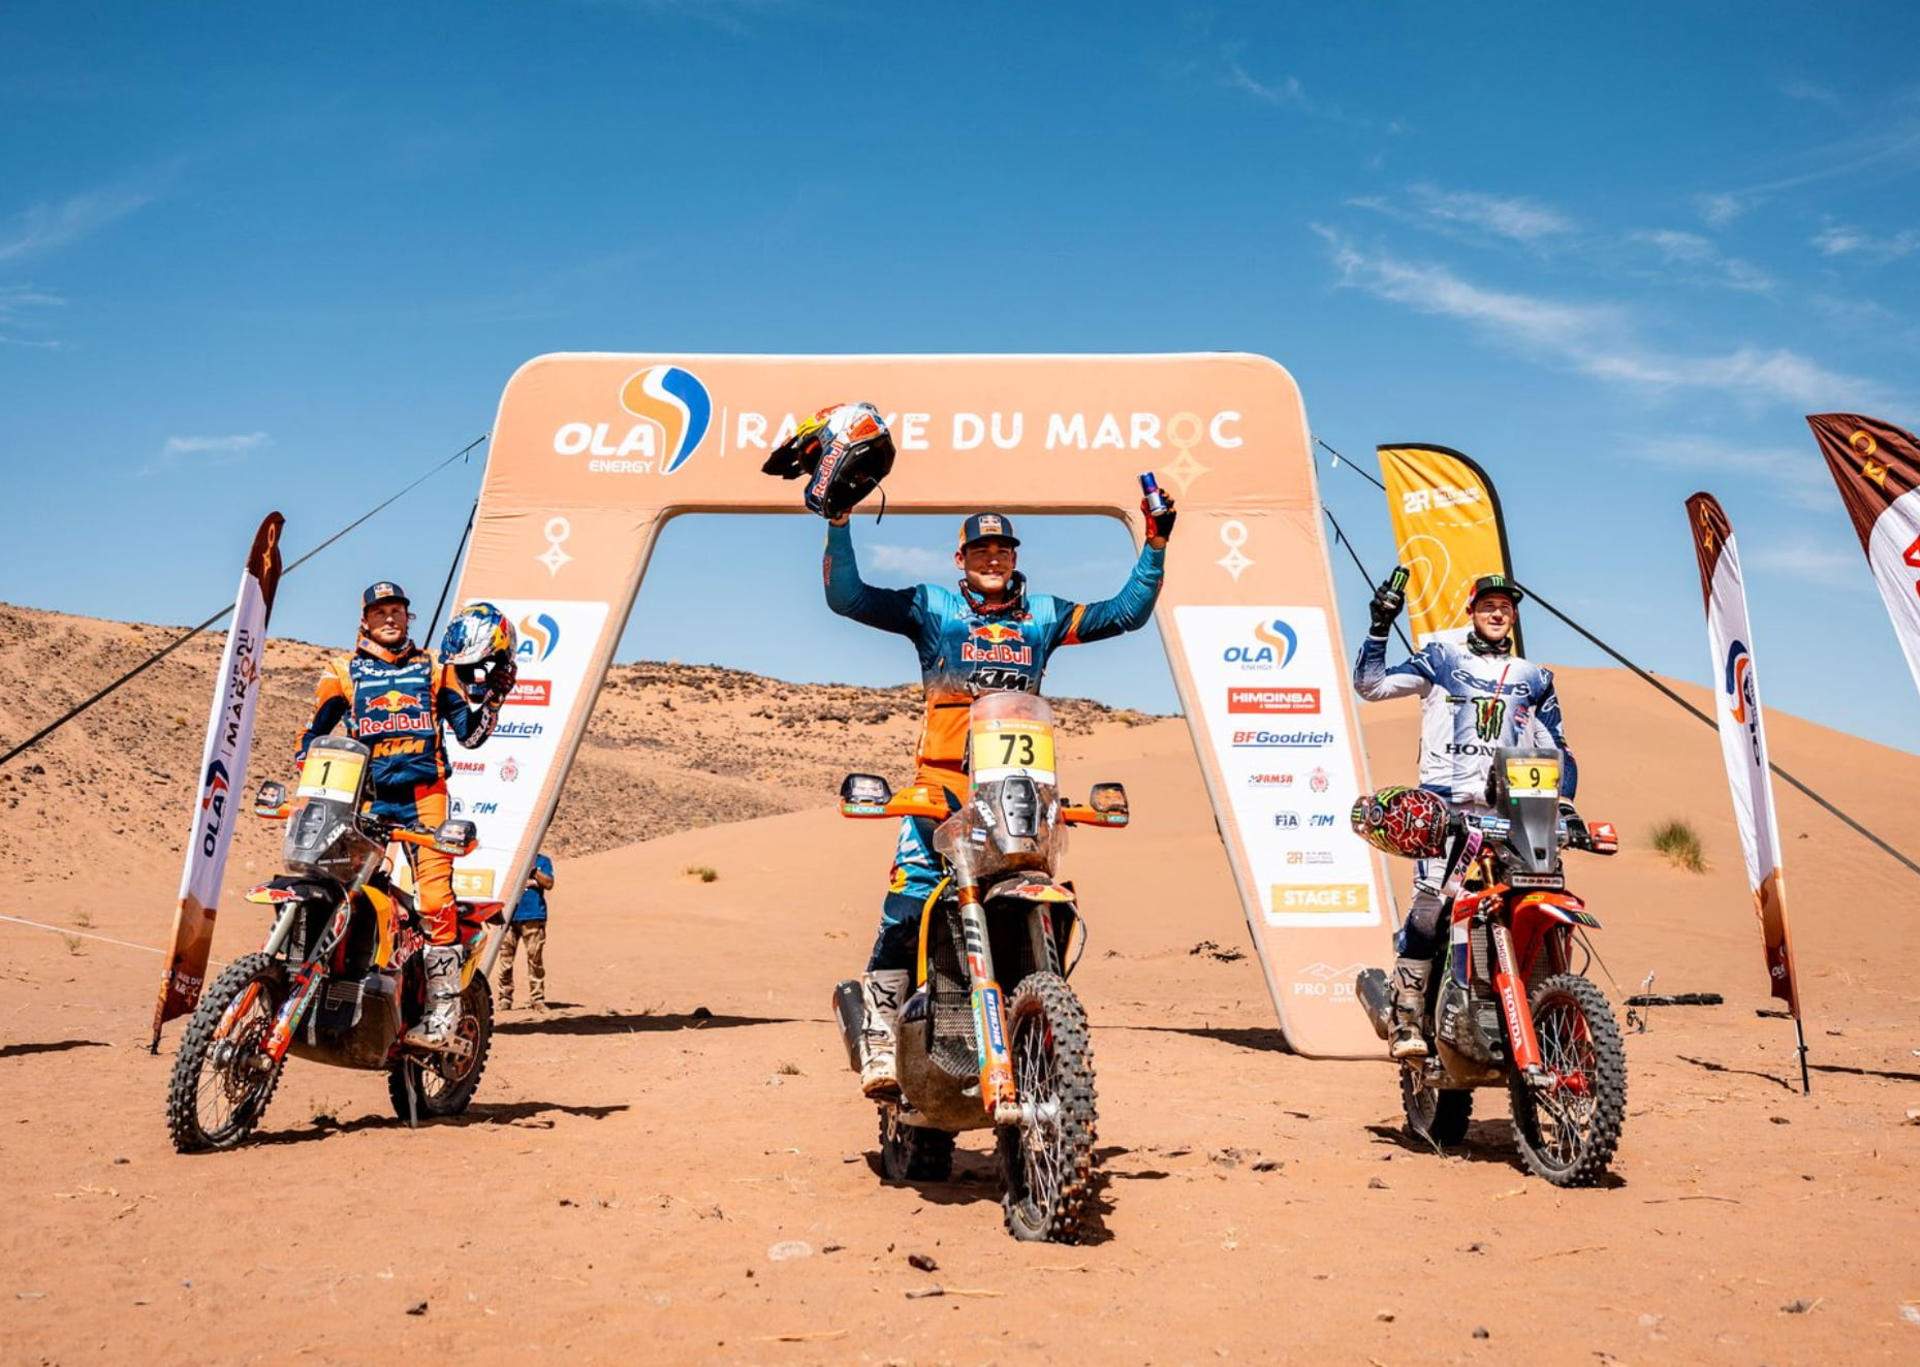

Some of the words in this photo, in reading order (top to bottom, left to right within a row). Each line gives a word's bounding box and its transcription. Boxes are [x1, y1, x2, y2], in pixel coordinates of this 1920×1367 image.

[554, 422, 656, 457] OLA
[952, 411, 1024, 450] DU
[1045, 411, 1244, 450] MAROC
[589, 460, 655, 474] ENERGY
[961, 642, 1000, 662] Red
[1000, 645, 1033, 666] Bull
[1224, 647, 1272, 662] OLA
[968, 666, 1029, 692] KTM
[360, 713, 396, 737] Red
[396, 711, 433, 731] Bull
[372, 736, 426, 758] KTM
[1000, 734, 1035, 766] 73
[1232, 731, 1334, 744] BFGoodrich
[1445, 743, 1496, 758] HON
[321, 760, 332, 786] 1
[1530, 767, 1541, 788] 9
[203, 794, 225, 858] OLA
[1284, 889, 1342, 905] STAGE
[1346, 889, 1357, 905] 5
[1294, 983, 1327, 996] PRO
[985, 991, 1003, 1045] MICHELIN
[1503, 986, 1523, 1050] HONDA
